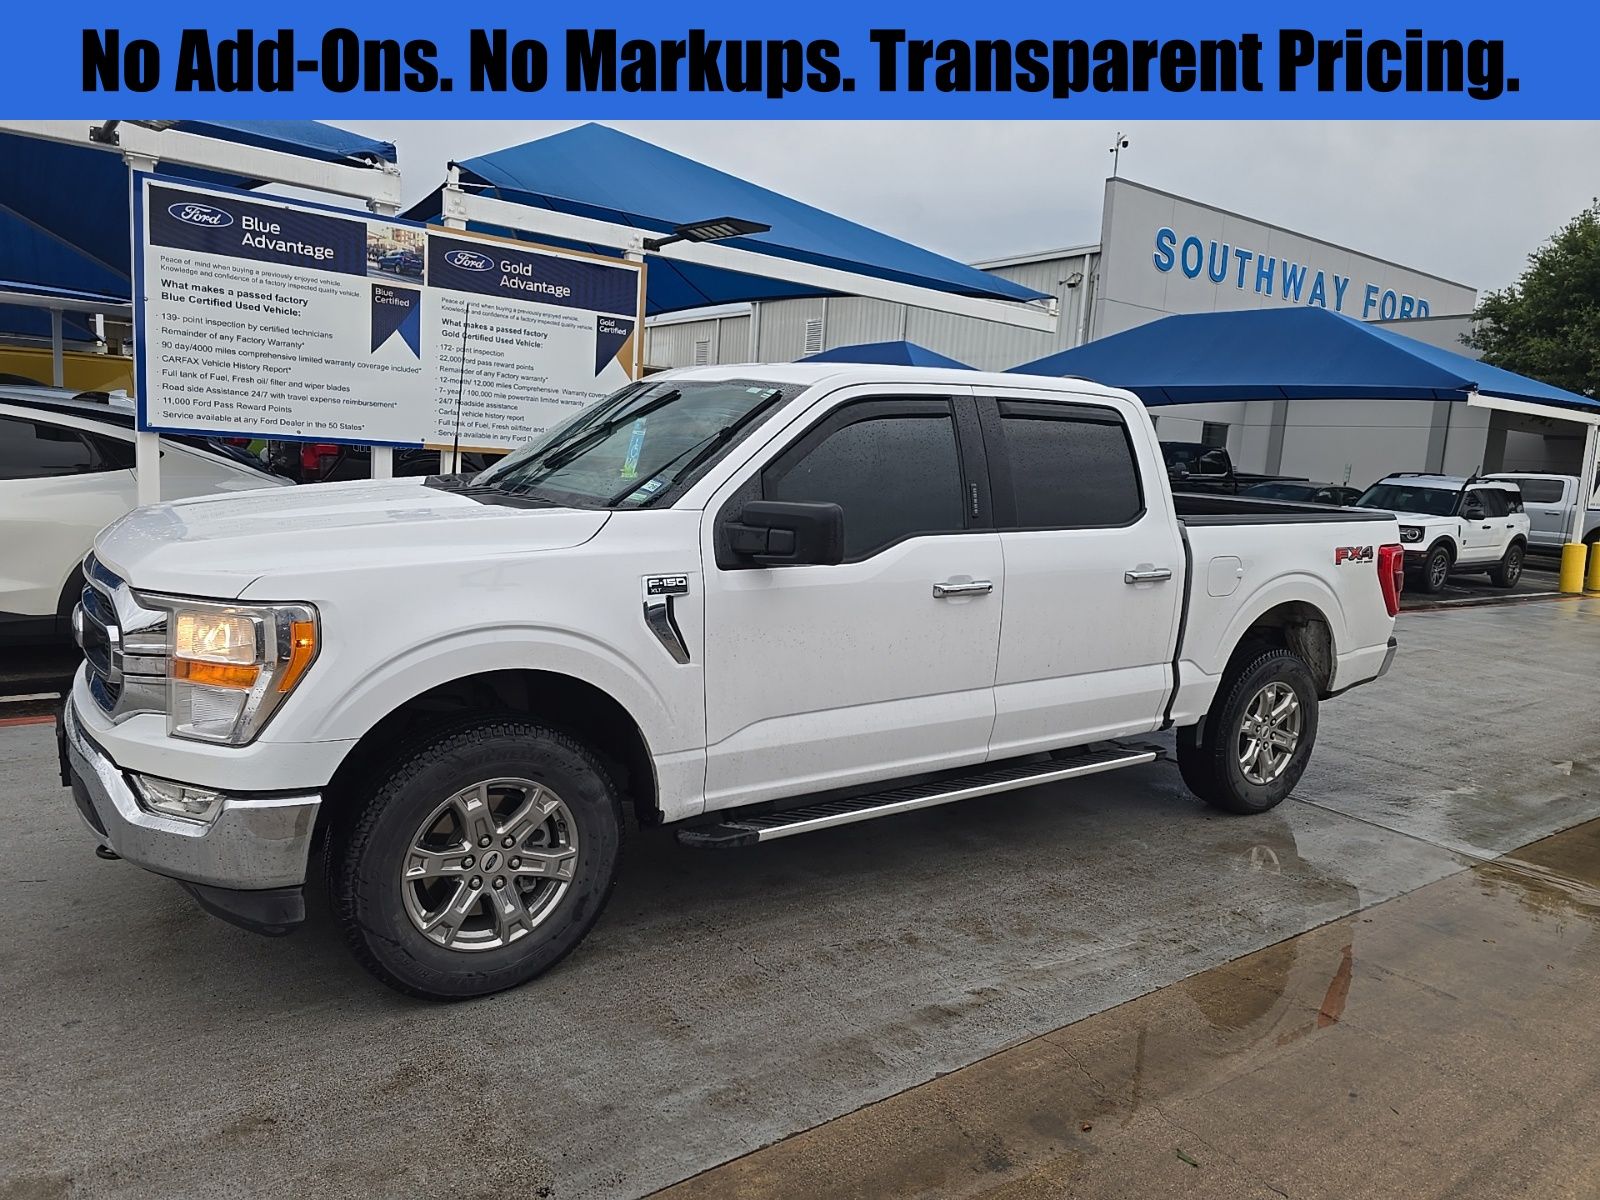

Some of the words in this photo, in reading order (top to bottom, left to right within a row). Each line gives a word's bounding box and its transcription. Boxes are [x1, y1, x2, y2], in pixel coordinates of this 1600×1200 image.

[181, 205, 222, 225] Ford
[241, 215, 281, 235] Blue
[241, 232, 335, 260] Advantage
[454, 252, 485, 269] Ford
[500, 261, 532, 276] Gold
[1153, 227, 1350, 312] SOUTHWAY
[1362, 282, 1431, 320] FORD
[161, 279, 188, 290] What
[192, 285, 224, 294] makes
[237, 291, 272, 301] passed
[275, 294, 308, 307] factory
[375, 287, 394, 297] Blue
[500, 275, 571, 297] Advantage
[162, 292, 185, 302] Blue
[189, 296, 232, 308] Certified
[236, 301, 260, 311] Used
[263, 305, 301, 317] Vehicle:
[375, 296, 410, 307] Certified
[162, 313, 180, 321] 139-
[183, 316, 203, 324] point
[206, 317, 245, 329] inspection
[248, 322, 258, 332] by
[260, 326, 289, 334] certified
[291, 328, 333, 339] technicians
[442, 318, 461, 327] What
[463, 321, 488, 331] makes
[496, 327, 522, 335] passed
[523, 329, 548, 339] factory
[599, 326, 627, 335] Certified
[162, 326, 207, 338] Remainder
[219, 335, 234, 343] any
[236, 335, 266, 346] Factory
[442, 330, 460, 338] Gold
[462, 332, 494, 342] Certified
[495, 336, 514, 345] Used
[515, 339, 543, 348] Vehicle:
[162, 341, 172, 349] 90
[175, 342, 213, 353] day/4000
[215, 347, 236, 355] miles
[238, 350, 297, 361] comprehensive
[299, 355, 323, 364] limited
[324, 359, 356, 368] warranty
[358, 362, 390, 371] coverage
[162, 355, 199, 365] CARFAX
[201, 358, 231, 368] Vehicle
[233, 361, 260, 372] History
[440, 365, 474, 375] Remaider
[162, 369, 177, 377] Full
[210, 373, 229, 382] Fuel,
[232, 375, 254, 383] Fresh
[270, 378, 287, 386] filter
[326, 384, 350, 392] blades
[440, 376, 472, 386] 12-moth/
[162, 383, 184, 391] Road
[187, 385, 204, 393] side
[206, 387, 249, 396] Assistance
[251, 390, 268, 398] 24/7
[163, 397, 190, 405] 11,000
[193, 399, 211, 407] Ford
[214, 401, 233, 409] Pass
[236, 402, 266, 411] Reward
[268, 405, 292, 413] Points
[439, 408, 460, 416] Carfa
[163, 411, 194, 419] Service
[196, 414, 232, 422] available
[243, 417, 258, 425] any
[260, 417, 278, 425] Ford
[280, 419, 305, 427] Dealer
[438, 430, 462, 438] Servie
[1335, 546, 1374, 565] FX4
[648, 578, 687, 587] F-150
